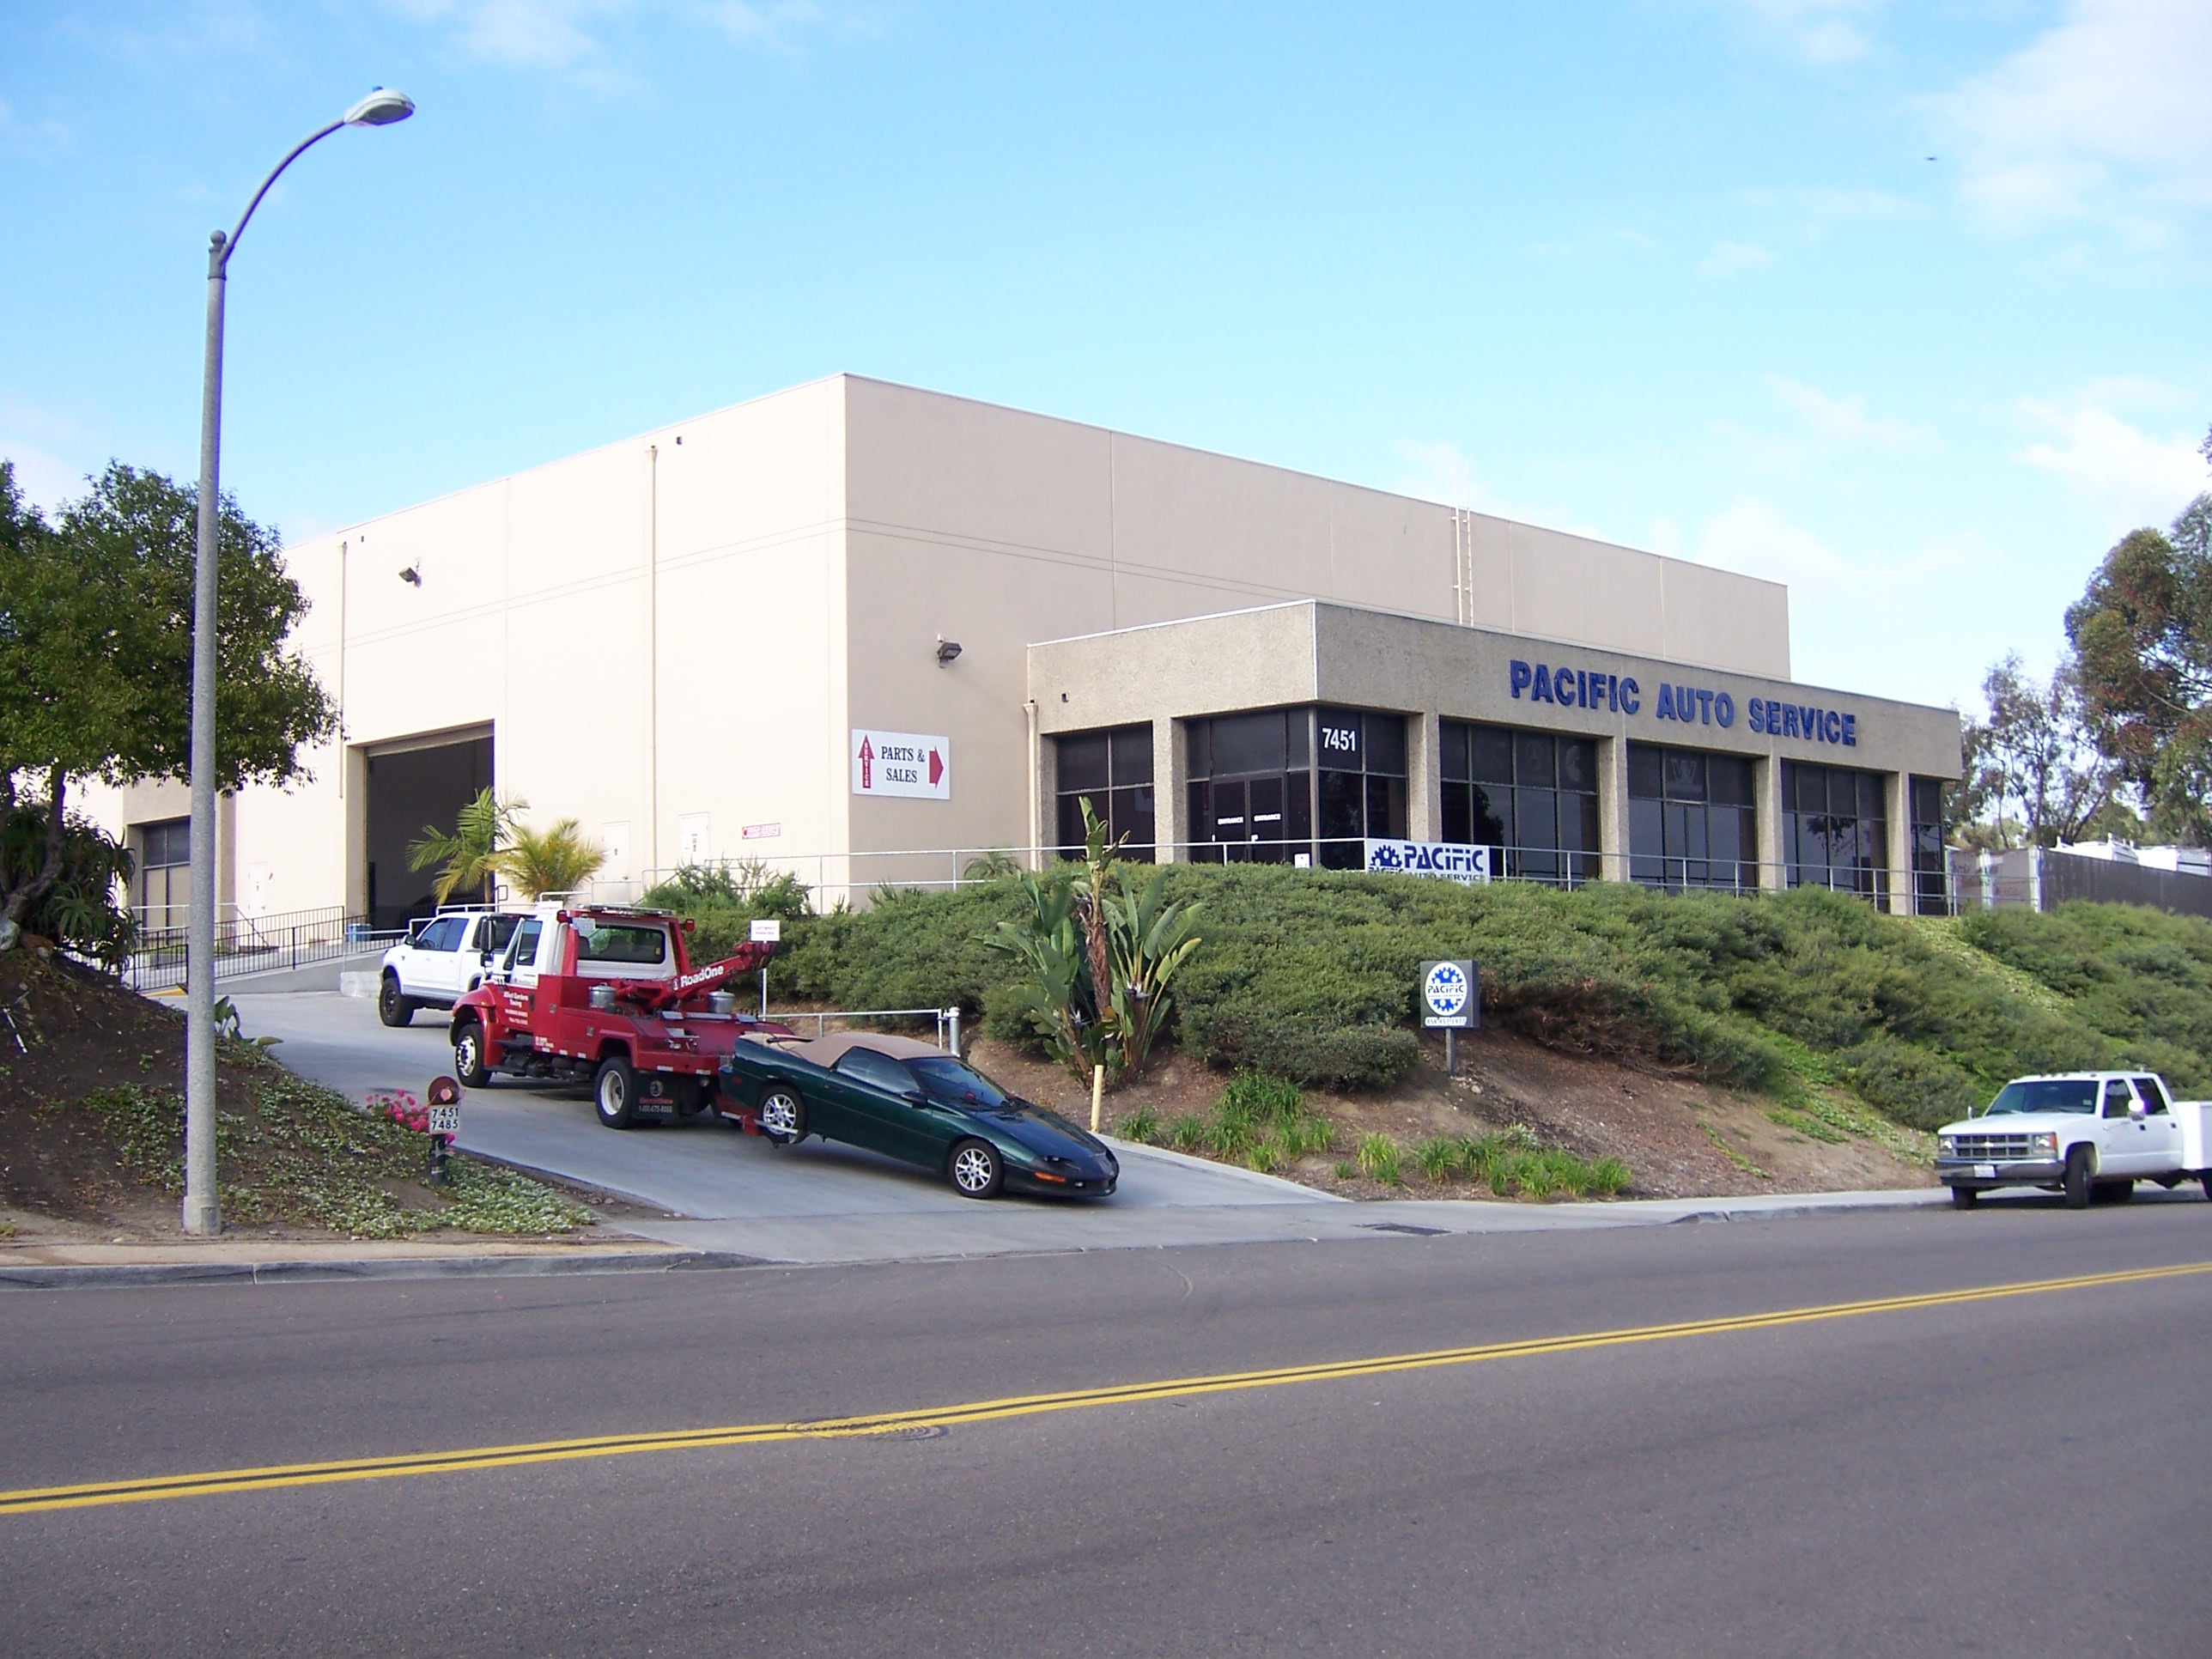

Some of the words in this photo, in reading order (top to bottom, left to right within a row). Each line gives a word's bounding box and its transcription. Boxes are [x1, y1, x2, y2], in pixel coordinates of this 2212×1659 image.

[1509, 659, 1640, 715] PACIFIC
[1656, 683, 1735, 728] AUTO
[1748, 696, 1857, 746] SERVICE
[1322, 726, 1357, 752] 7451
[881, 745, 915, 763] PARTS
[916, 749, 927, 763] &
[885, 768, 918, 783] SALES
[1404, 845, 1484, 872] PACIFIC
[680, 965, 724, 988] RoadOne
[1427, 985, 1465, 994] PACIFIC
[432, 1108, 459, 1118] 7451
[432, 1119, 459, 1130] 7485
